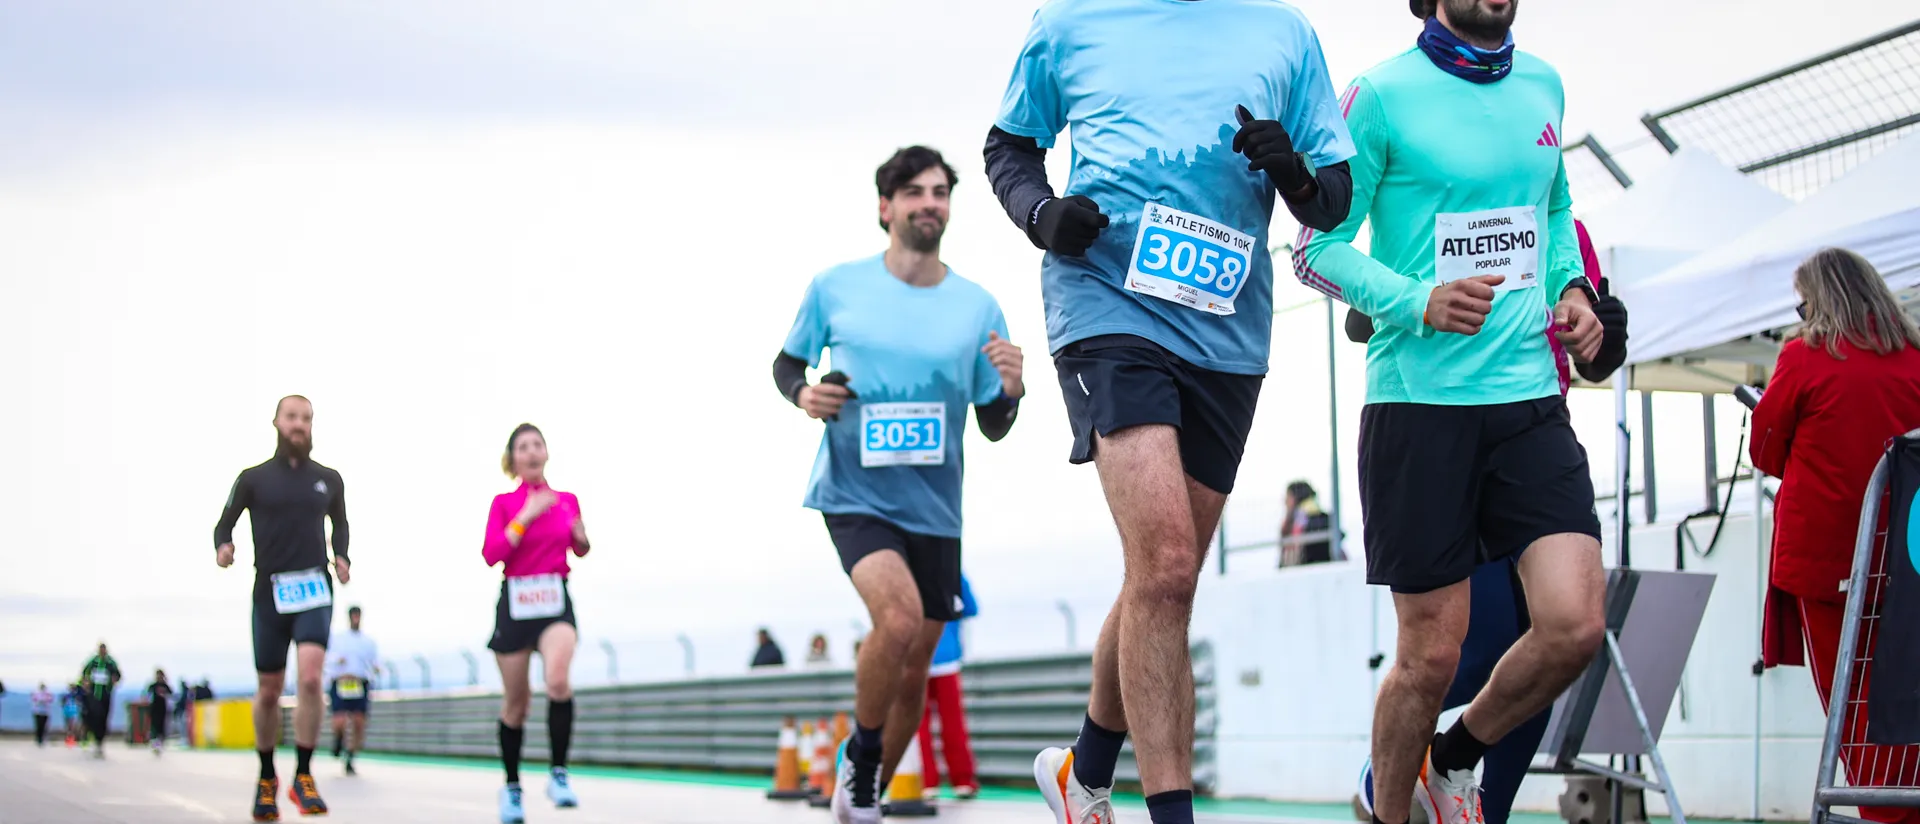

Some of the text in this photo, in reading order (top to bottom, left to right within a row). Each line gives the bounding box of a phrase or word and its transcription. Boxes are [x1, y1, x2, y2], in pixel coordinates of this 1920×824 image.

[1165, 214, 1230, 243] ATLETISMO
[1233, 237, 1251, 252] 10K
[1468, 217, 1513, 230] LA INVERNAL
[1441, 230, 1535, 256] ATLETISMO
[1143, 234, 1242, 292] 3058
[1475, 257, 1511, 269] POPULAR
[1177, 284, 1199, 296] MIGUEL
[869, 421, 937, 449] 3051
